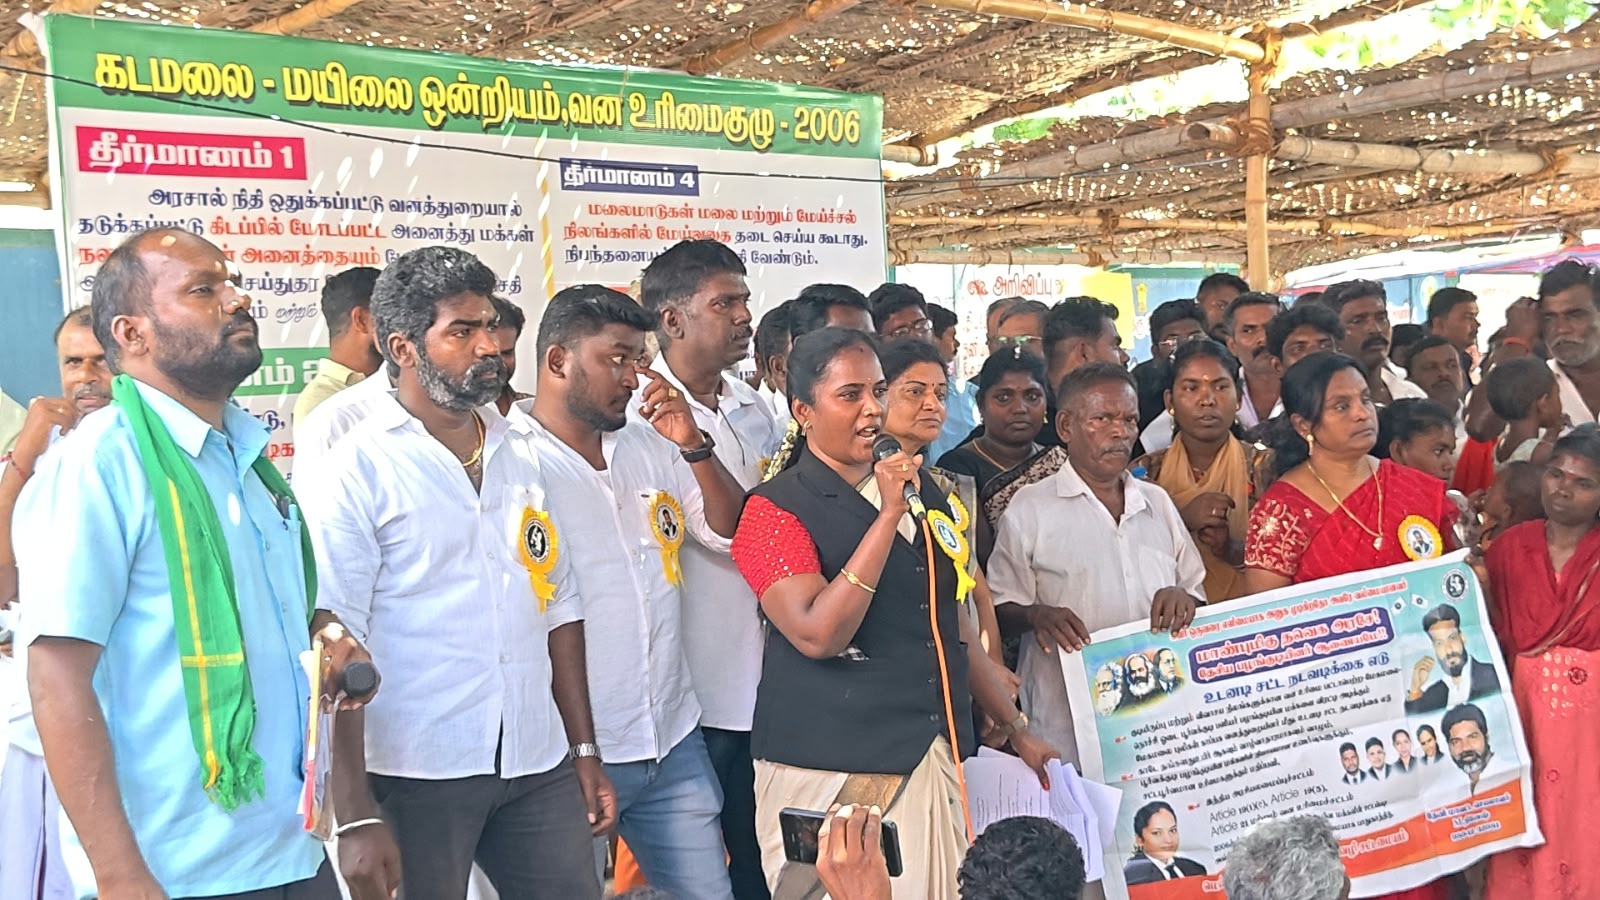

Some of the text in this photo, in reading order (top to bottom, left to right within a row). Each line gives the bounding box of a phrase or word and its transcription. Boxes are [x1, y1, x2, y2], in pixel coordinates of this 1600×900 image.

[95, 52, 254, 99] கடமலை
[283, 61, 412, 112] மயிலை
[629, 91, 774, 151] உரிமைகுழு
[794, 106, 860, 145] 2006
[89, 131, 293, 169] தீர்மானம் 1
[564, 160, 696, 188] தீர்மானம் 4
[149, 187, 522, 218] அரசால் நிதி ஒதுக்கப்பட்டு வனத்துறையால்
[588, 203, 857, 225] மலைமாடுகள் மலை மற்றும் மேய்ச்சல்
[210, 216, 284, 236] கிடப்பில்
[290, 219, 387, 239] போடப்பட்ட
[392, 222, 475, 244] அனைத்து
[480, 223, 535, 243] மக்கள்
[564, 221, 652, 241] நிலங்களில்
[735, 231, 770, 243] தடை
[773, 228, 815, 244] செய்ய
[818, 234, 868, 248] கூடாது.
[241, 244, 380, 267] அனைத்தையும்
[751, 249, 818, 266] வேண்டும்.
[1197, 635, 1279, 662] மாண்புமிகு
[1204, 652, 1389, 703] உடனடி சட்ட நடவடிக்கை எடு
[1210, 808, 1236, 823] Article
[1271, 789, 1299, 804] Article
[1211, 822, 1238, 837] Article
